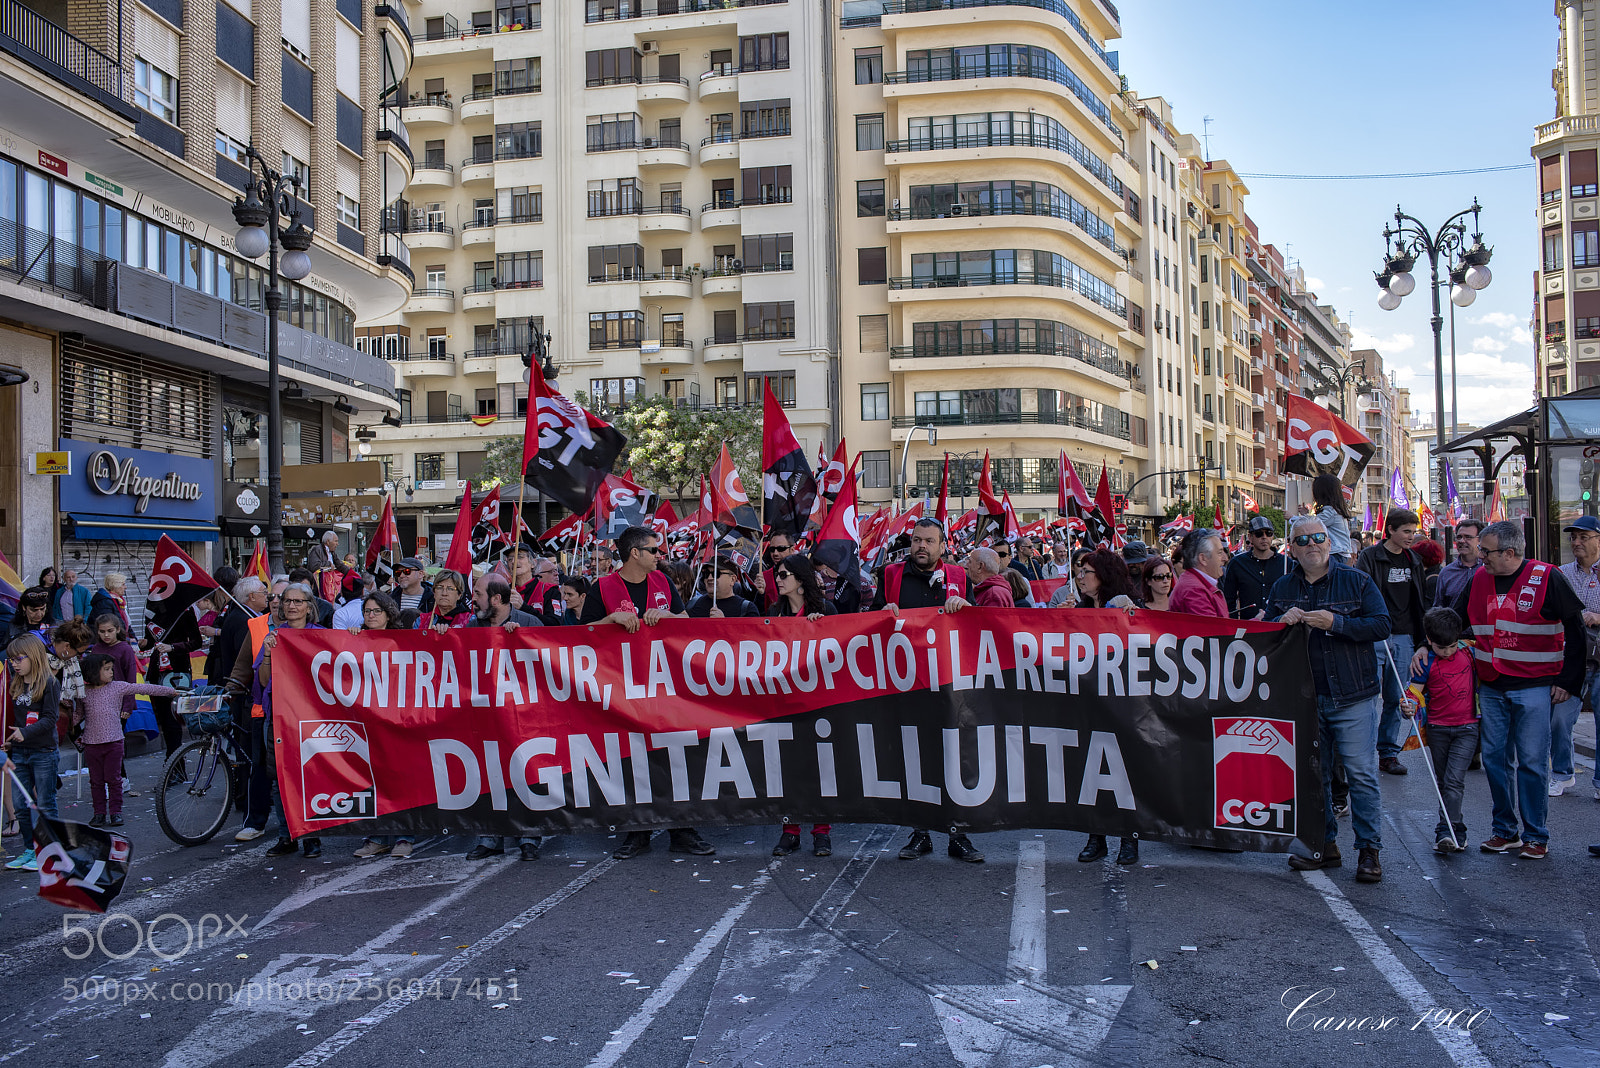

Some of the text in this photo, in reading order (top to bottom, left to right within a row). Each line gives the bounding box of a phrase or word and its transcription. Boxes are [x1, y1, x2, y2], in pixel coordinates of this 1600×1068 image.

[152, 203, 195, 232] MOBILIARIO
[311, 276, 339, 298] PAVIMENTOS
[33, 380, 39, 394] 3
[1287, 418, 1363, 480] CGT
[96, 456, 109, 478] La
[93, 450, 203, 514] Argentina
[239, 496, 259, 507] COLORS
[311, 619, 1271, 711] CONTRA L'ATUR, LA CORRUPCIÓ i LA REPRESSIÓ:
[428, 718, 1137, 812] DIGNITAT i LLUITA
[310, 791, 372, 815] CGT
[1222, 799, 1292, 829] CGT
